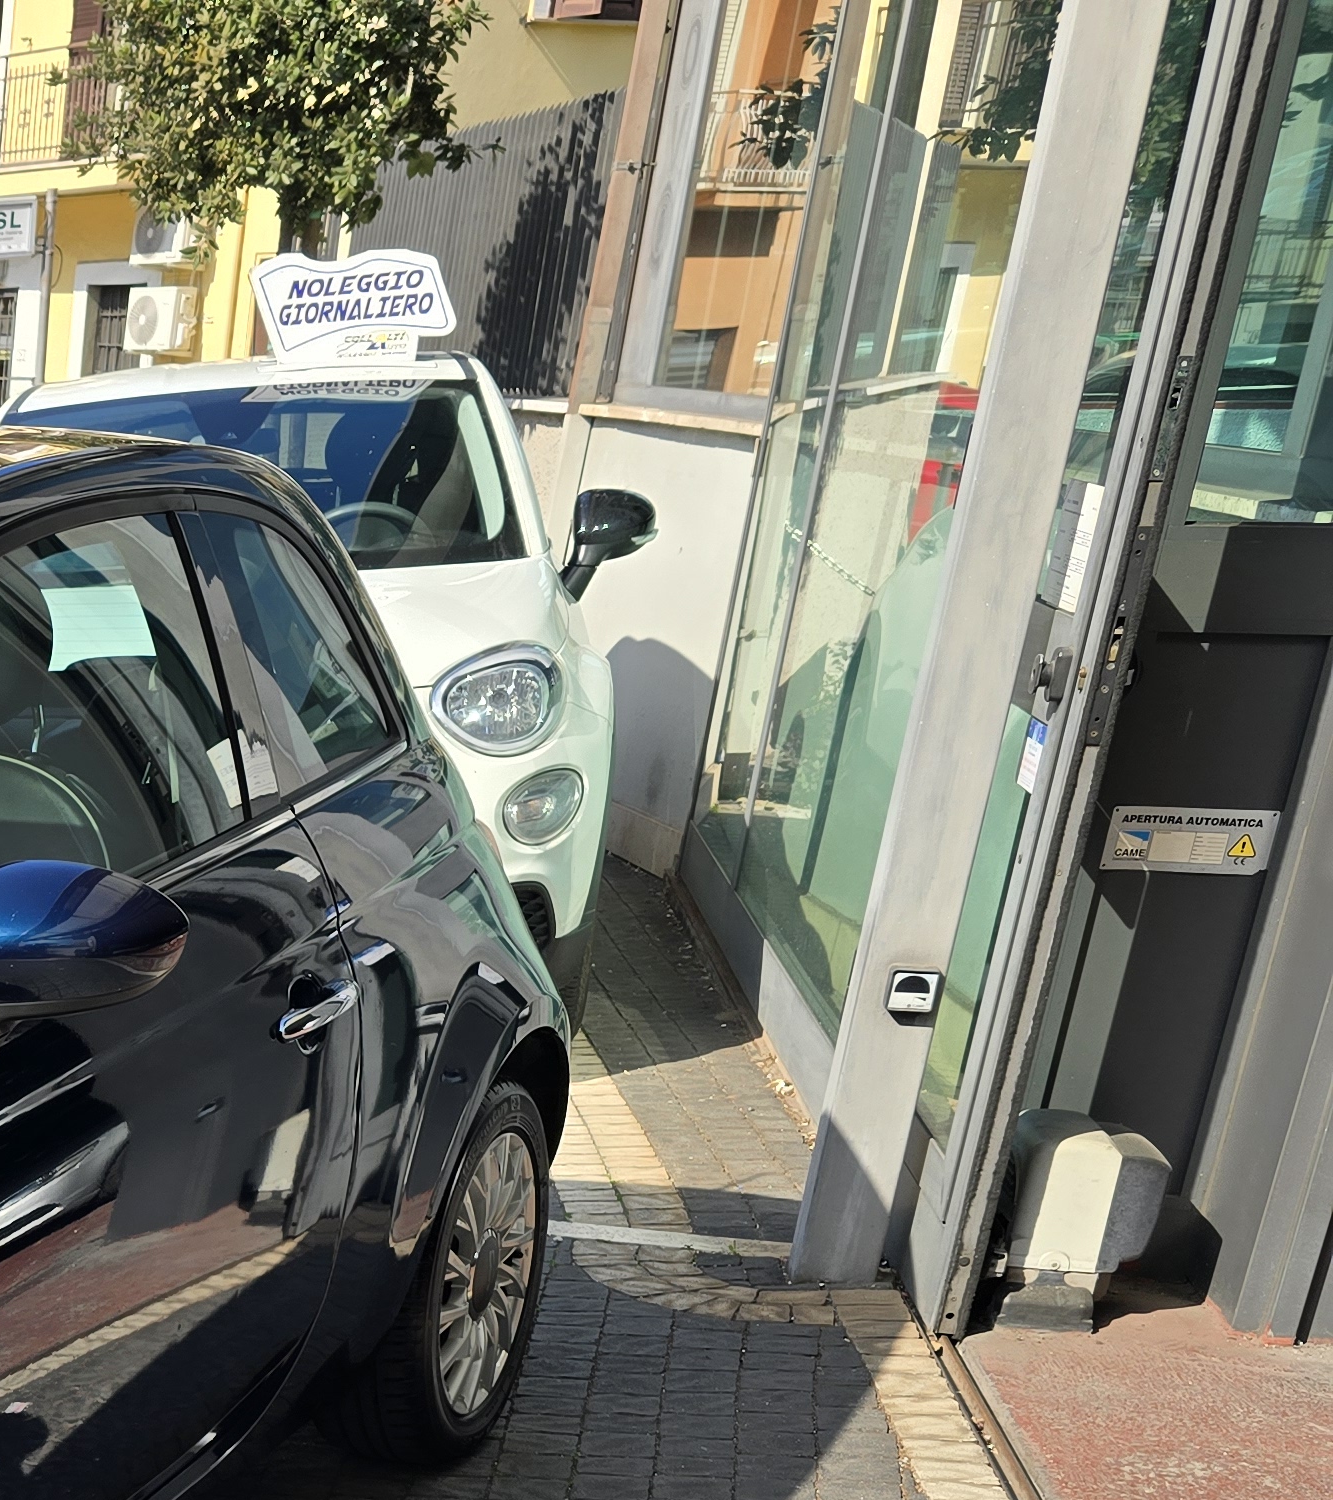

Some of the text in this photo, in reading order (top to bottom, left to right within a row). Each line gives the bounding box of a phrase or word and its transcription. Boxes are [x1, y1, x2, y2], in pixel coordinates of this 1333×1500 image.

[287, 269, 425, 300] NOLEGGIO
[279, 292, 434, 326] GIORNALIERO
[1121, 814, 1264, 828] APERTURA AUTOMATICA
[1114, 848, 1146, 857] CAME
